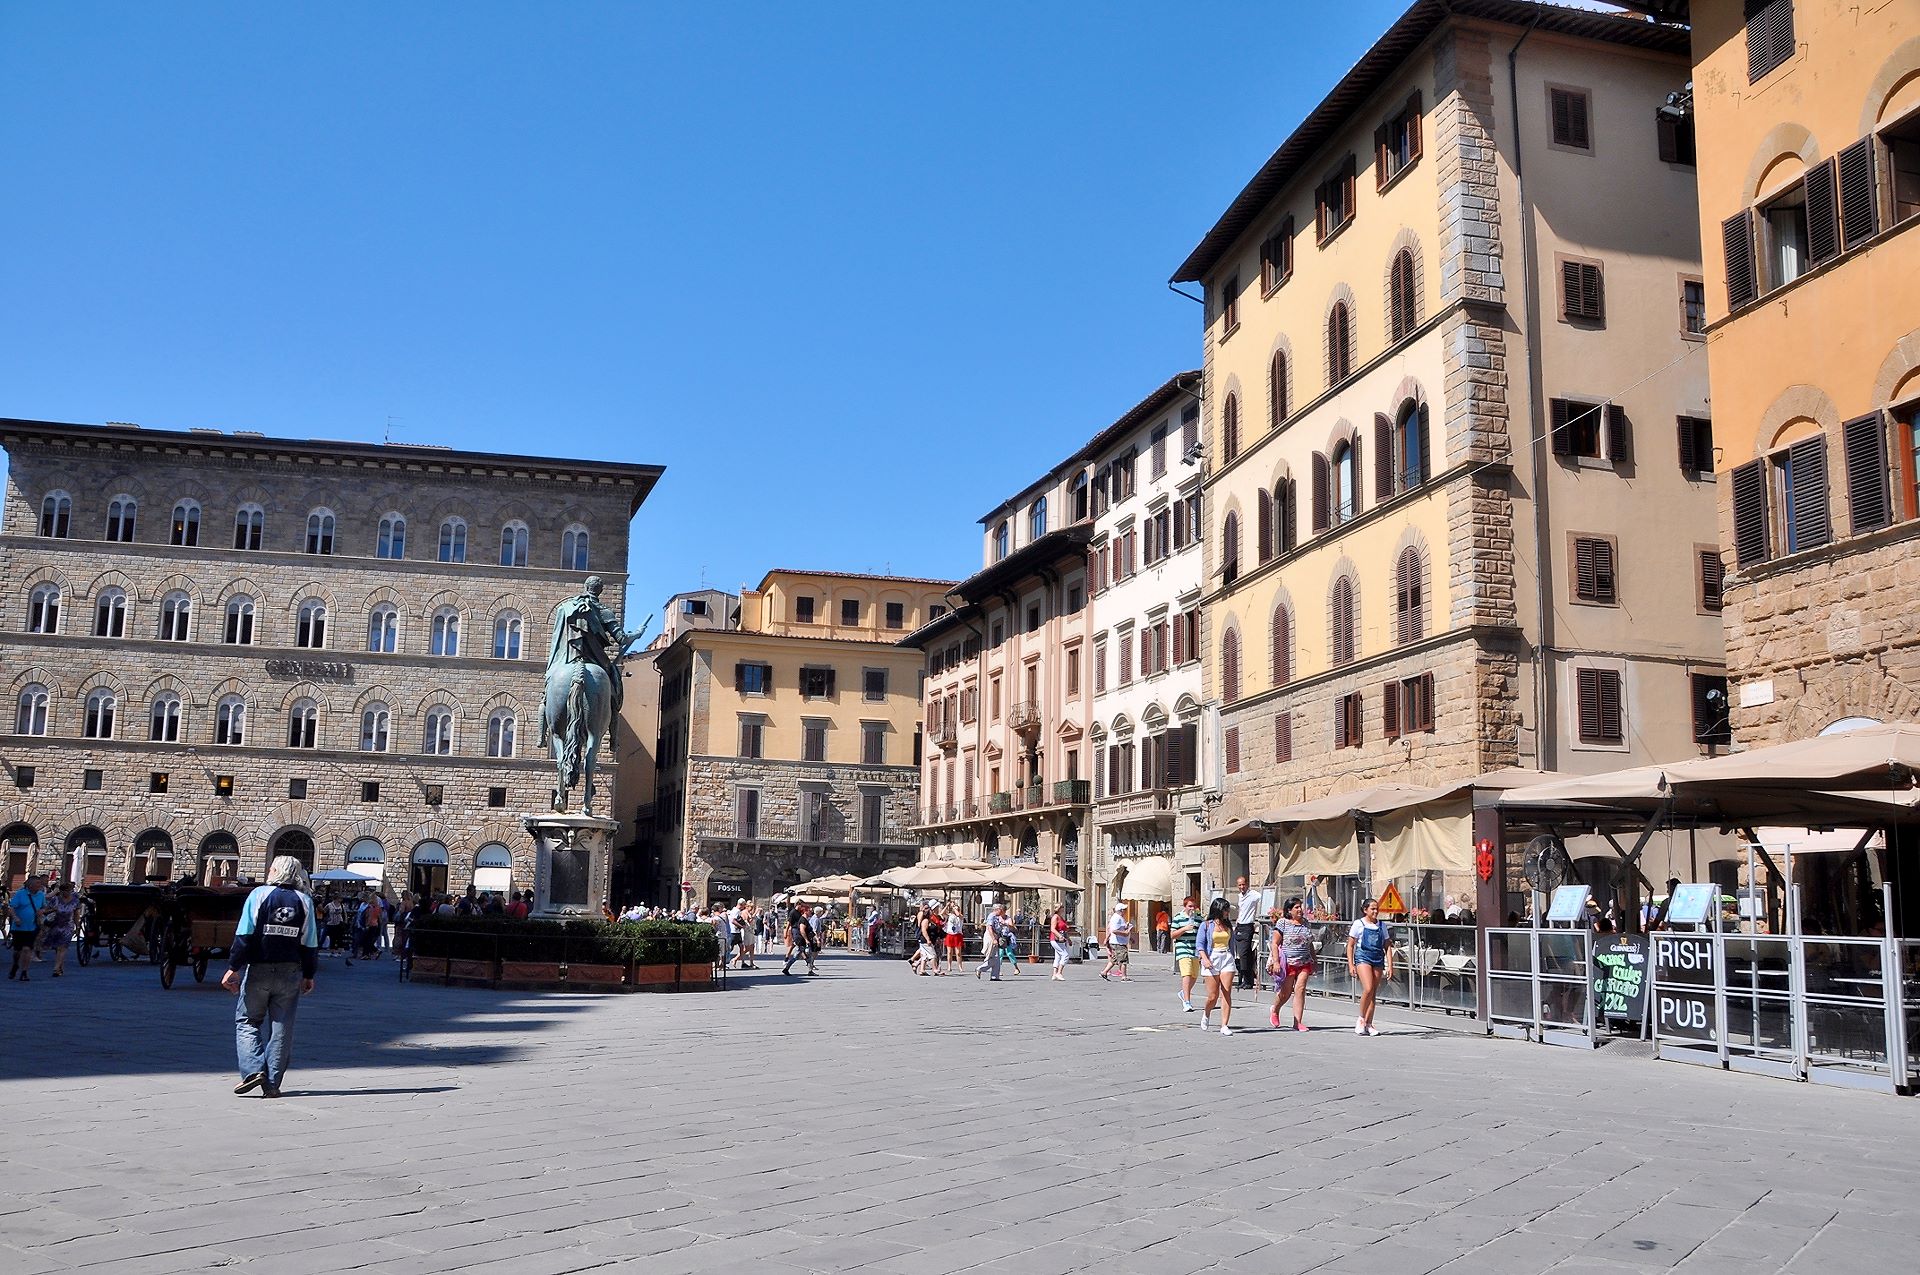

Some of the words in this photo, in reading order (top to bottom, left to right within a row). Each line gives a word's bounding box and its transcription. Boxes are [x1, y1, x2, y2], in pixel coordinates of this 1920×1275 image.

[1110, 844, 1133, 856] BANCA
[1134, 842, 1172, 854] TOSCANA
[1661, 997, 1707, 1028] PUB
